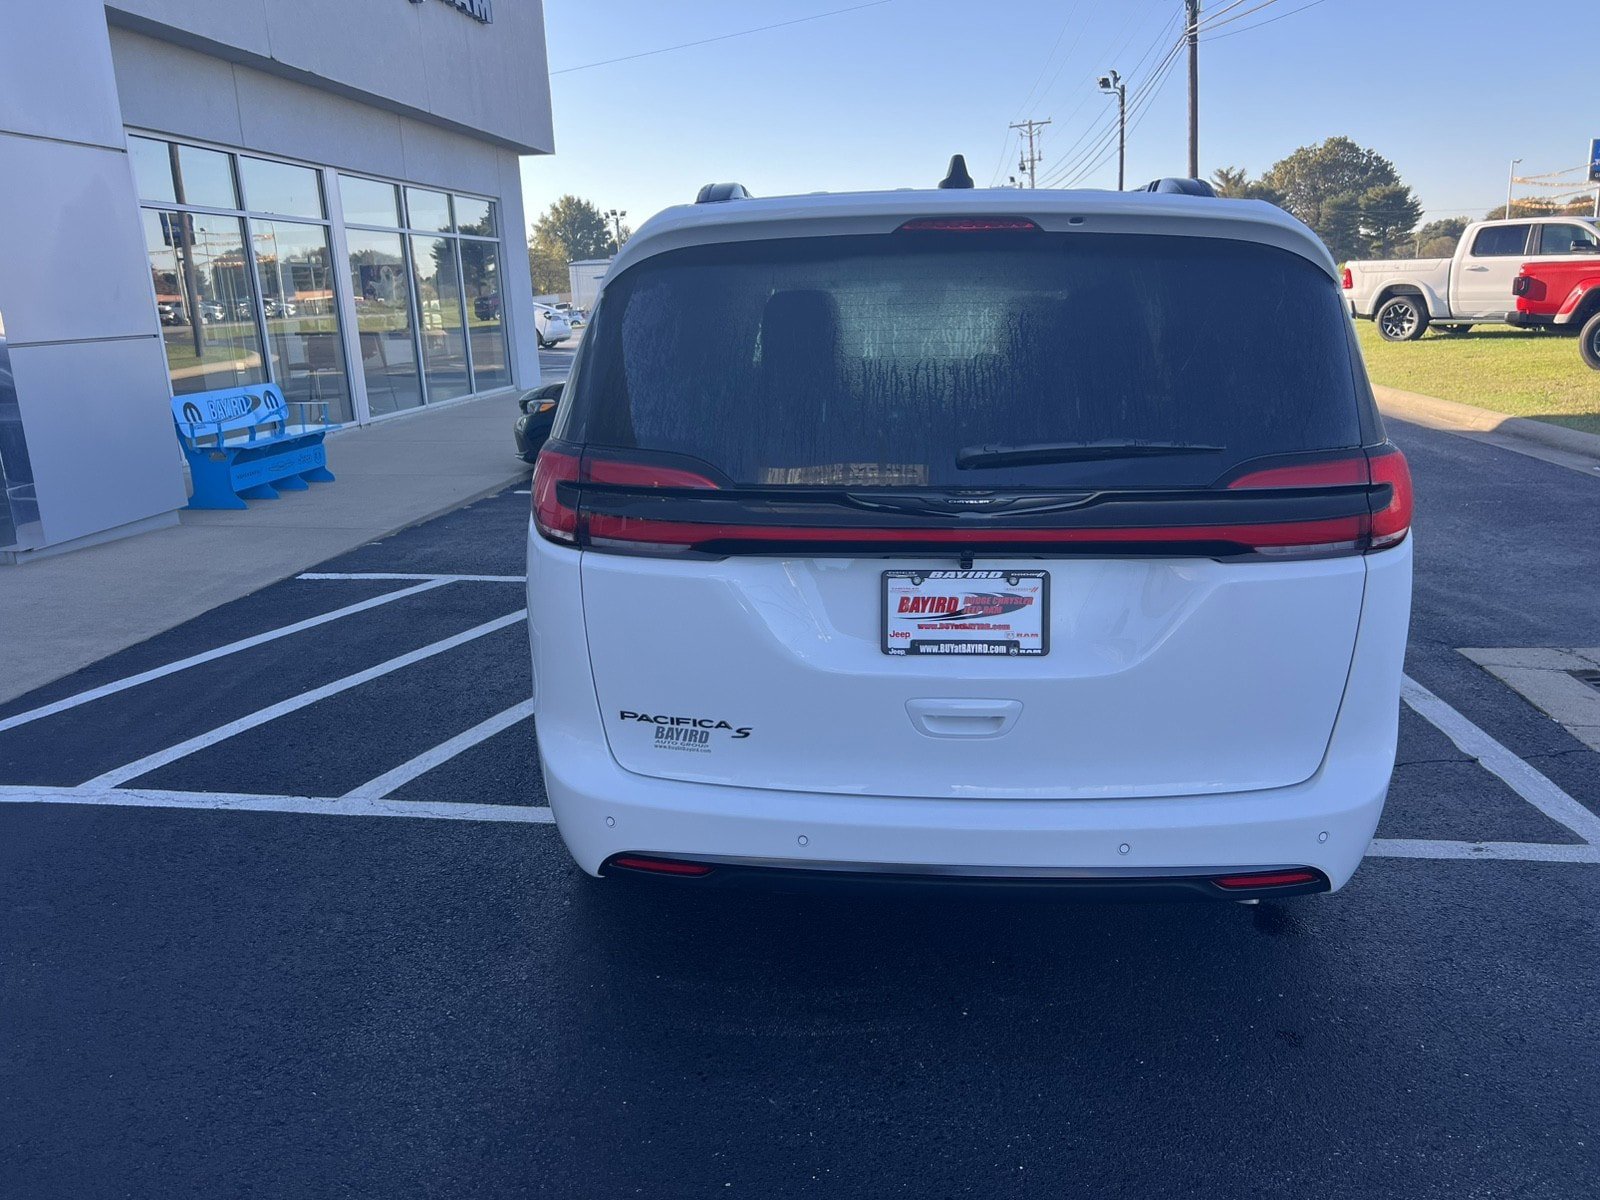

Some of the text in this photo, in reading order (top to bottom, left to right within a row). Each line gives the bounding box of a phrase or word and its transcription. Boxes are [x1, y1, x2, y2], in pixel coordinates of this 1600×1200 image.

[206, 396, 248, 420] BAYIRD
[928, 570, 1004, 579] BAYIRD
[897, 596, 960, 614] BAYIRD
[889, 630, 911, 639] Jeep
[920, 643, 1007, 654] www.BUYatBAYIRD.com
[620, 710, 753, 739] PACIFICA S
[654, 725, 710, 744] BAYIRD
